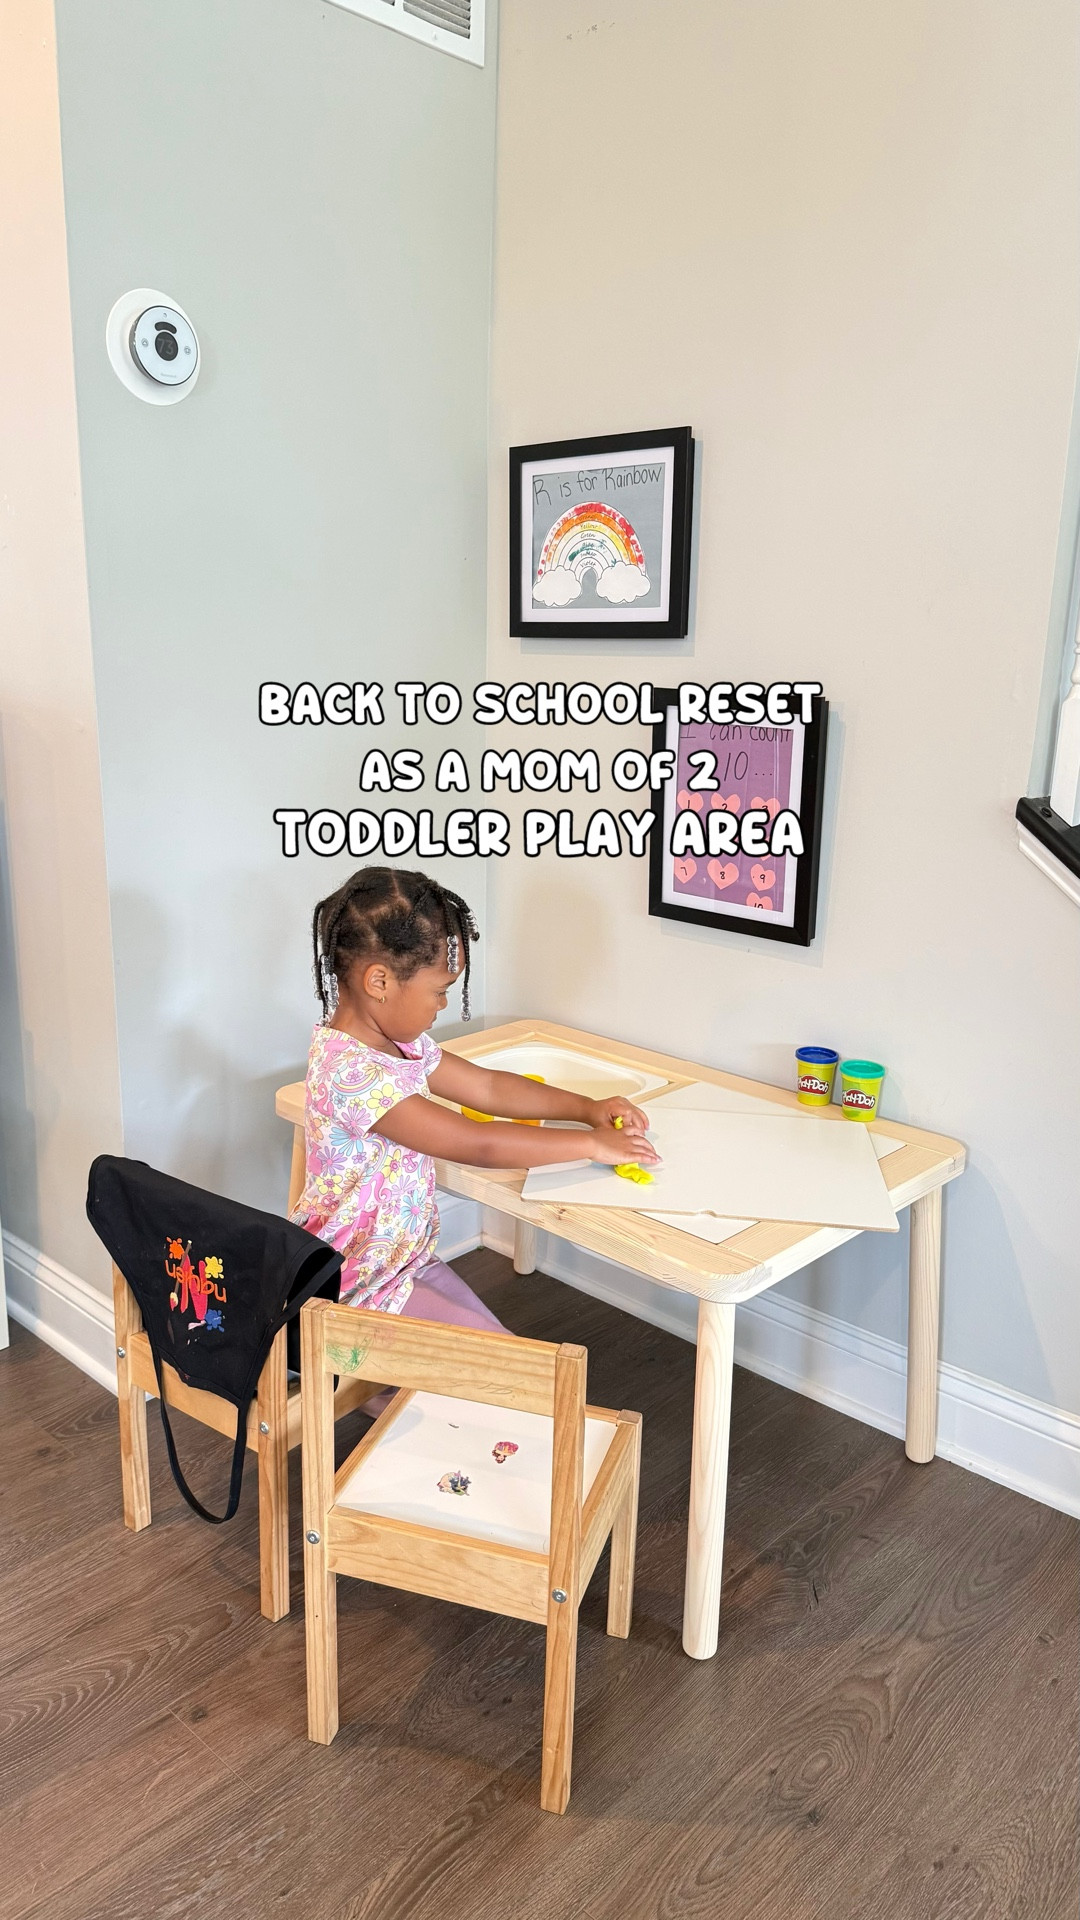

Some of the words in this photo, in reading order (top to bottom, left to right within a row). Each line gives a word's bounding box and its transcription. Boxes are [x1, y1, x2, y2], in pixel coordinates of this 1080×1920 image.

[533, 479, 551, 505] R
[558, 476, 571, 497] is
[576, 470, 597, 492] for
[602, 466, 662, 490] Rainbow
[720, 871, 726, 880] 8
[759, 874, 766, 884] 9
